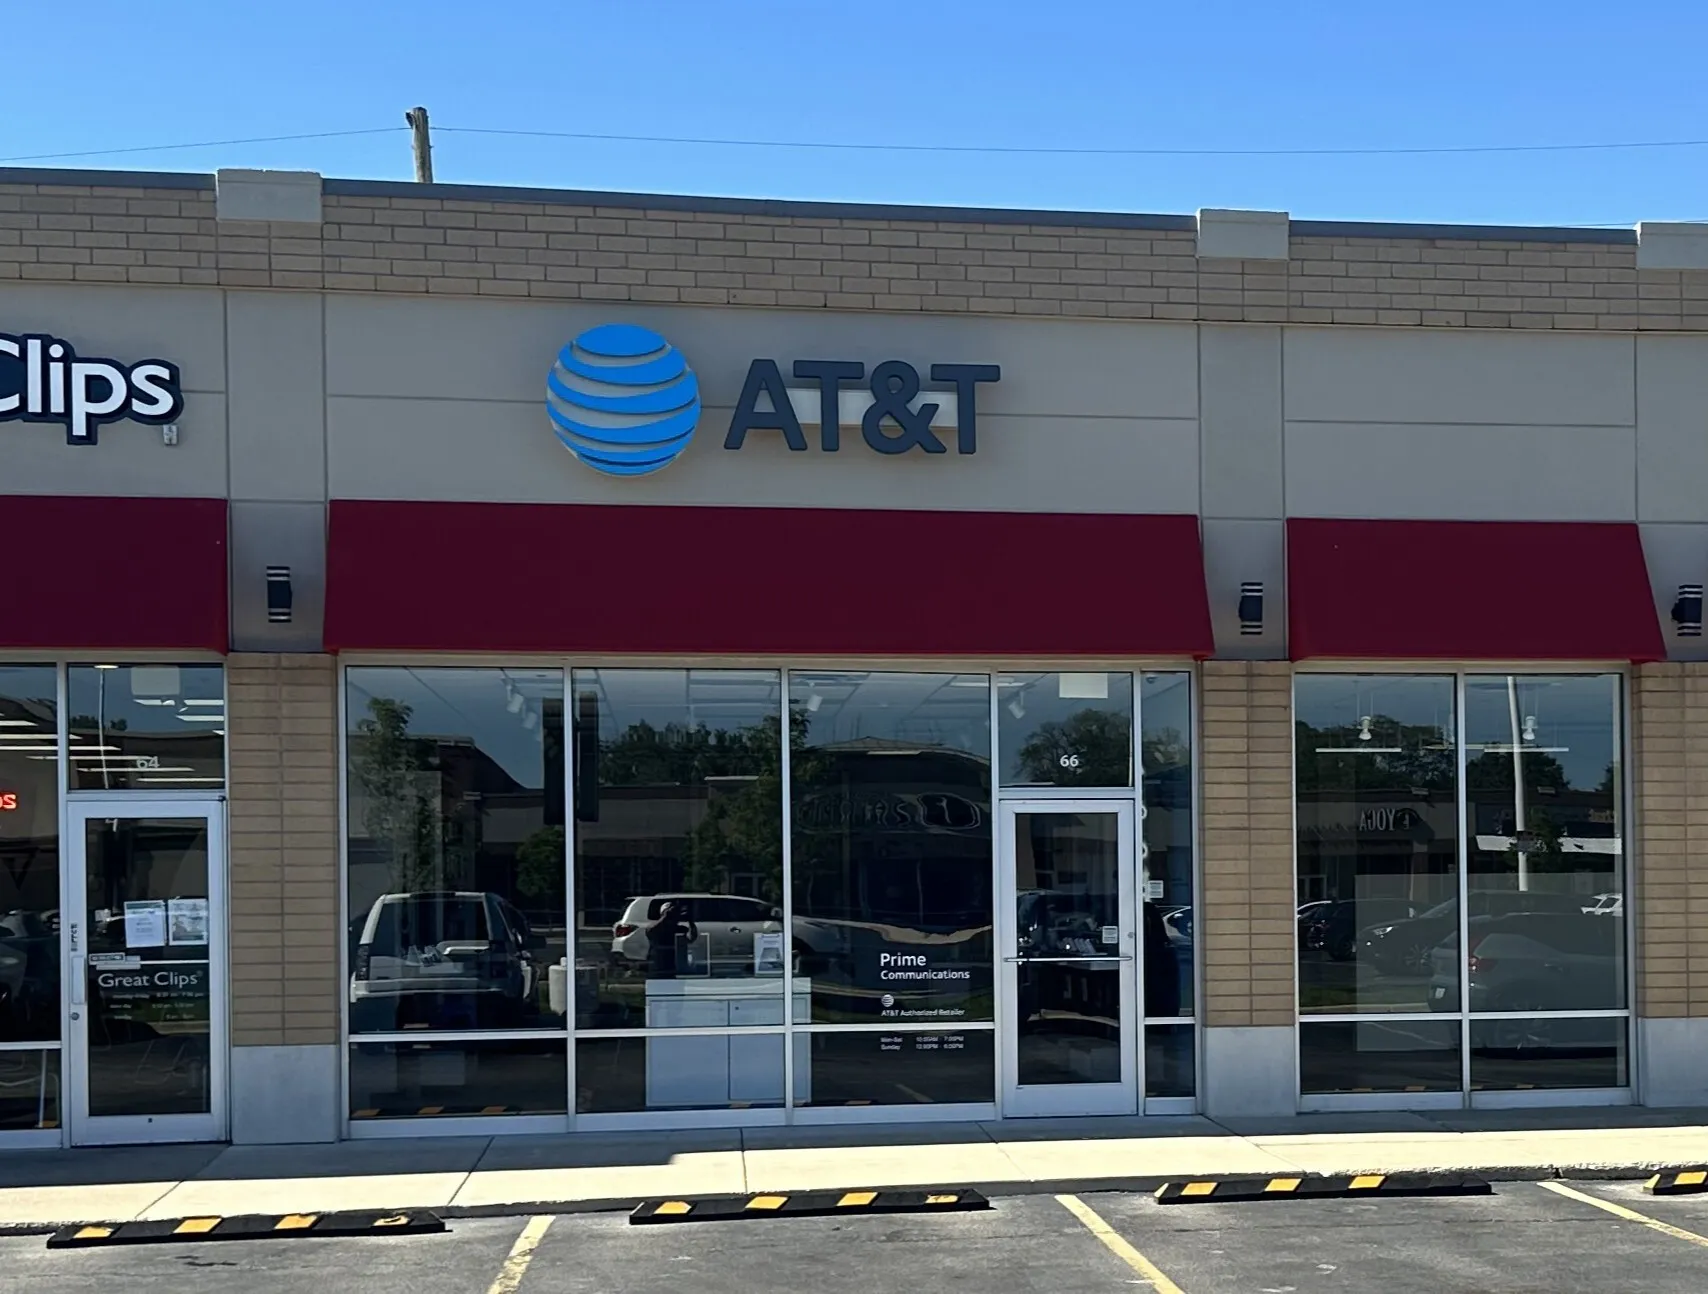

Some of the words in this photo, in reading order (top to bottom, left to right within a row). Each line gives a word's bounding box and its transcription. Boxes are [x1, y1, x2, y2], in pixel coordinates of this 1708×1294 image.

[0, 338, 175, 437] lips
[724, 359, 1000, 454] AT&T
[136, 756, 160, 769] 64
[1060, 754, 1079, 767] 66
[880, 952, 927, 966] Prime
[98, 973, 150, 987] Great
[154, 971, 198, 989] Clips
[880, 969, 971, 979] Communications
[900, 1008, 938, 1016] Authorized
